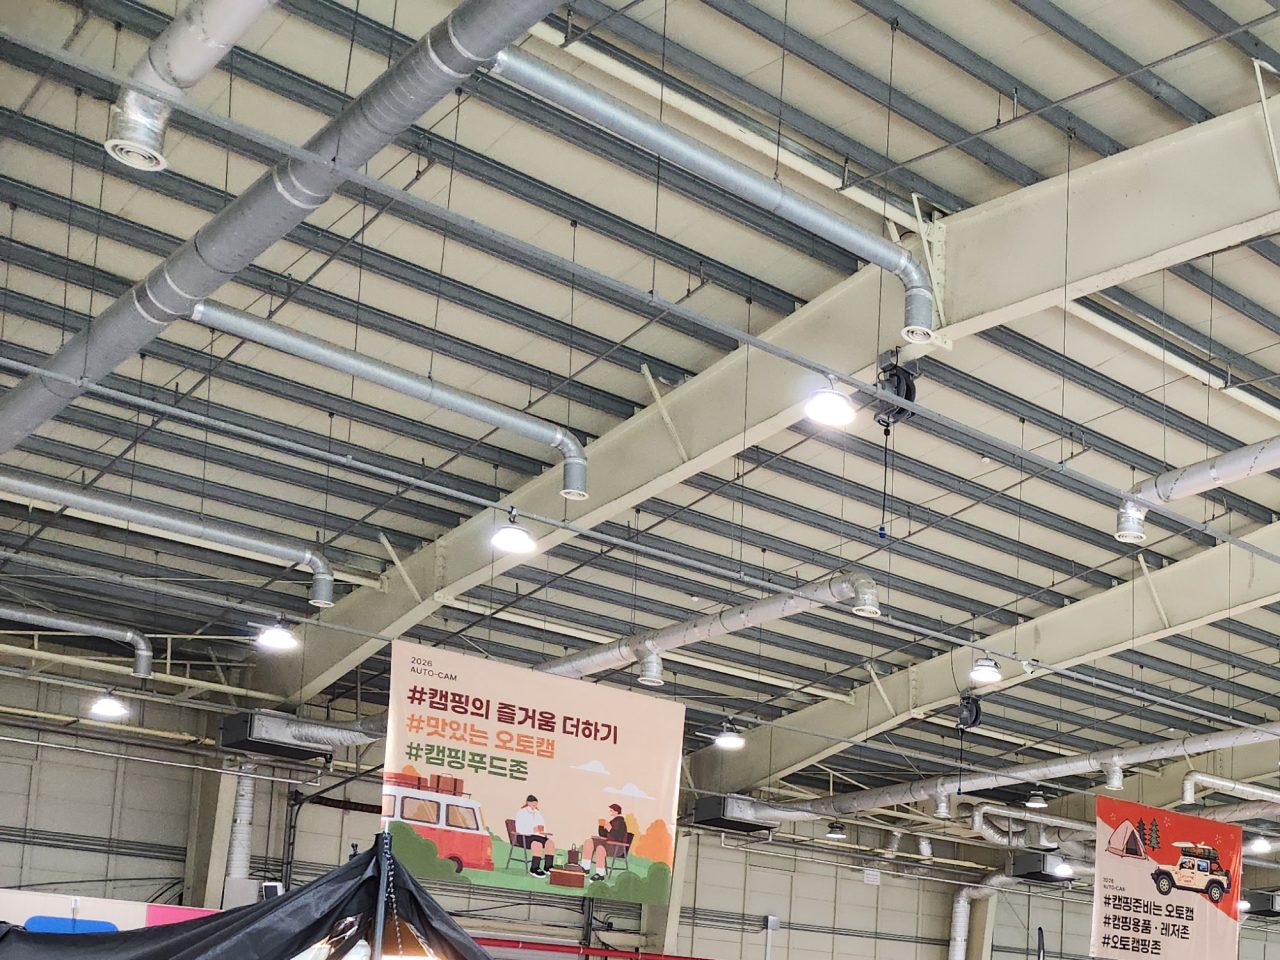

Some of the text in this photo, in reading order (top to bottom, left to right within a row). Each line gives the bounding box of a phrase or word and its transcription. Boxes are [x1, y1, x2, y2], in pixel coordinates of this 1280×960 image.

[410, 656, 433, 667] 2026
[410, 666, 457, 681] AUTO-CAM
[407, 685, 618, 745] #캠핑의 즐거움 더하기
[405, 713, 555, 760] #맛있는 오토캠
[405, 741, 528, 782] #캠핑푸드존
[1103, 893, 1194, 921] #캠핑준비는 오토캠
[1103, 913, 1152, 934] #캠핑용품
[1160, 922, 1190, 940] 레저존
[1101, 933, 1161, 955] #오토캠핑존
